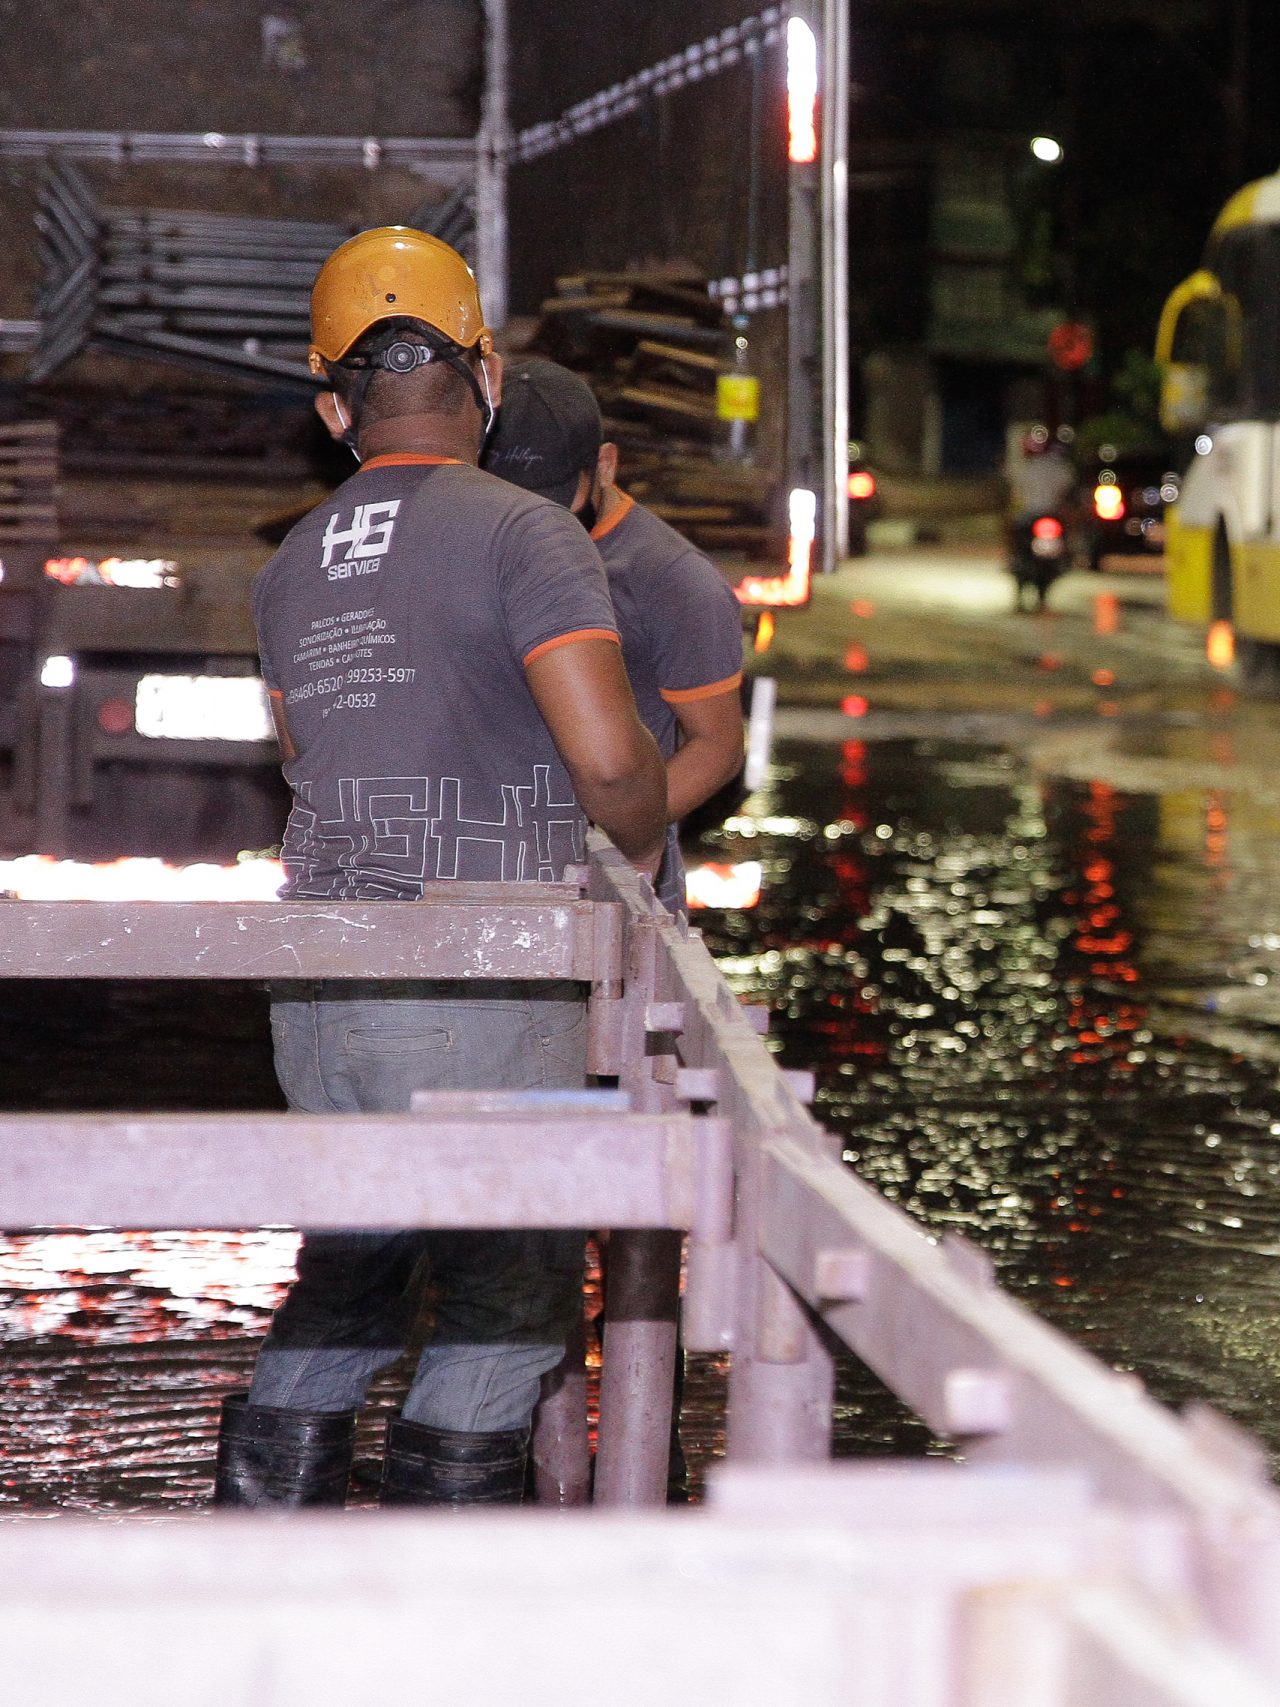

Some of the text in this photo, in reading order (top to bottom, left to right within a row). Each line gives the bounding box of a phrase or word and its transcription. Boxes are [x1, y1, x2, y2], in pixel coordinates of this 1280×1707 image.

[327, 558, 381, 580] service
[311, 616, 335, 630] PALCOS
[309, 657, 334, 671] TENDAS
